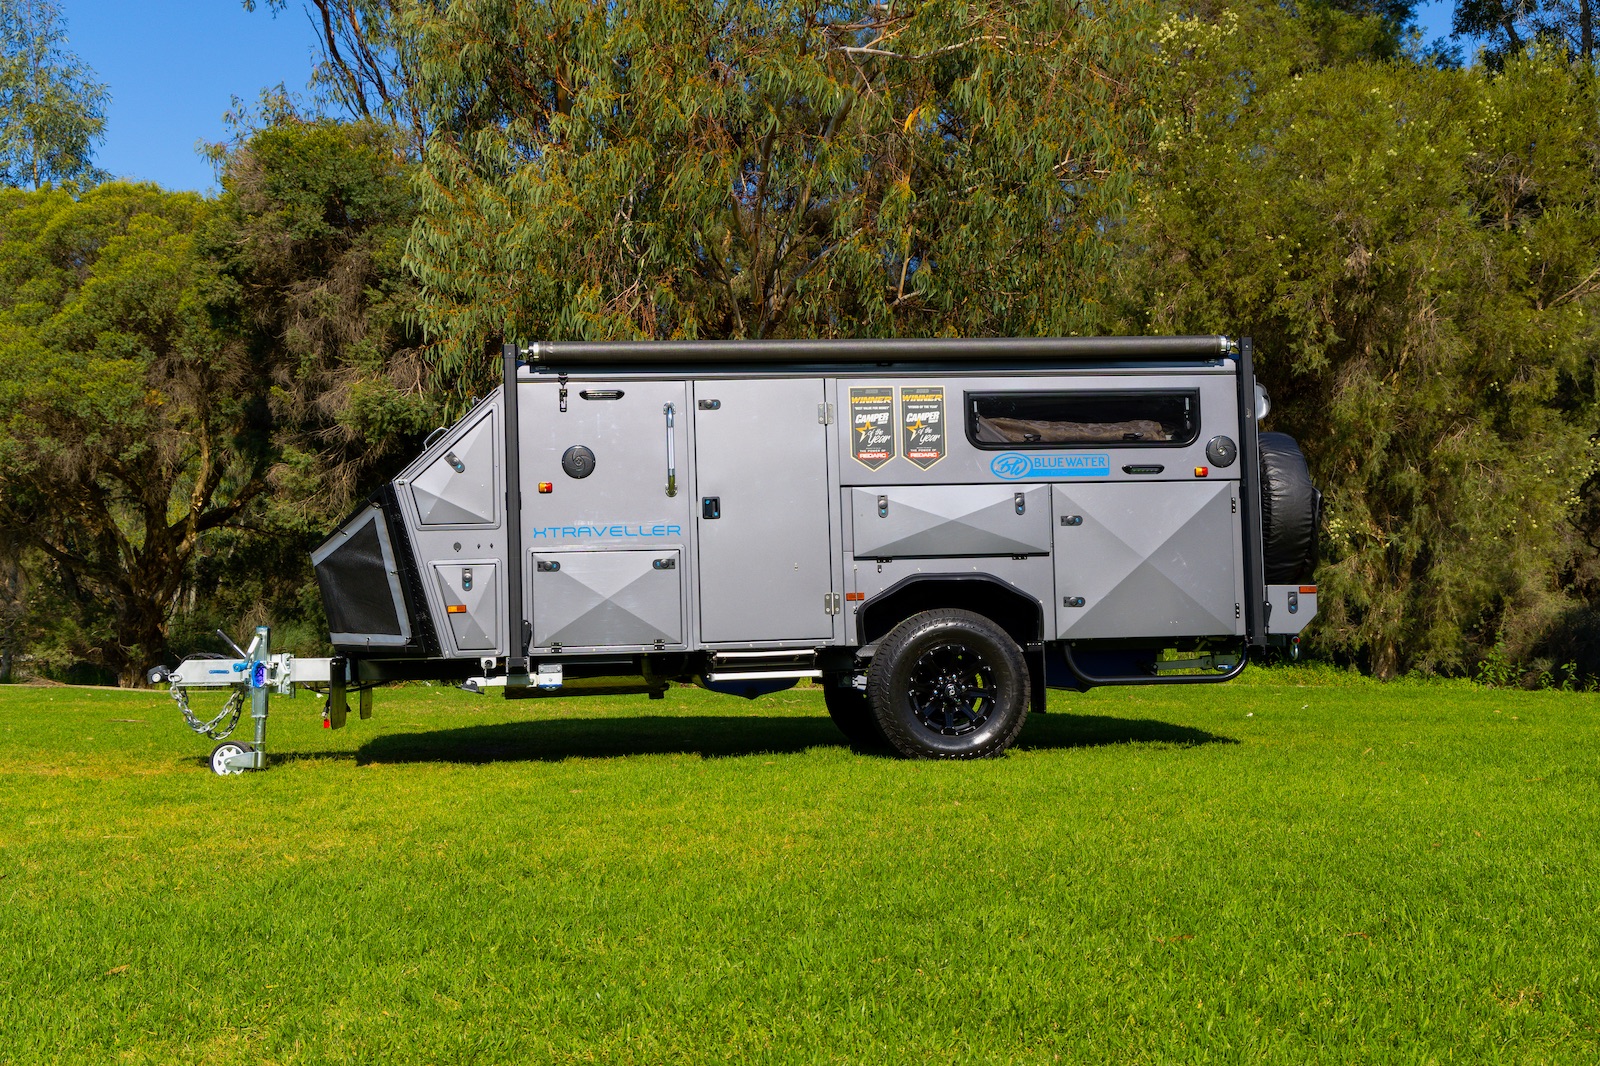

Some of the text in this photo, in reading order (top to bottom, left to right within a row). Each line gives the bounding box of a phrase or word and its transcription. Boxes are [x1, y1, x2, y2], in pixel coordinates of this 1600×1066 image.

[852, 396, 892, 404] WINNER
[902, 394, 943, 402] WINNER
[855, 412, 890, 424] CAMPER
[906, 411, 940, 423] CAMPER
[533, 525, 681, 539] XTRAVELLER
